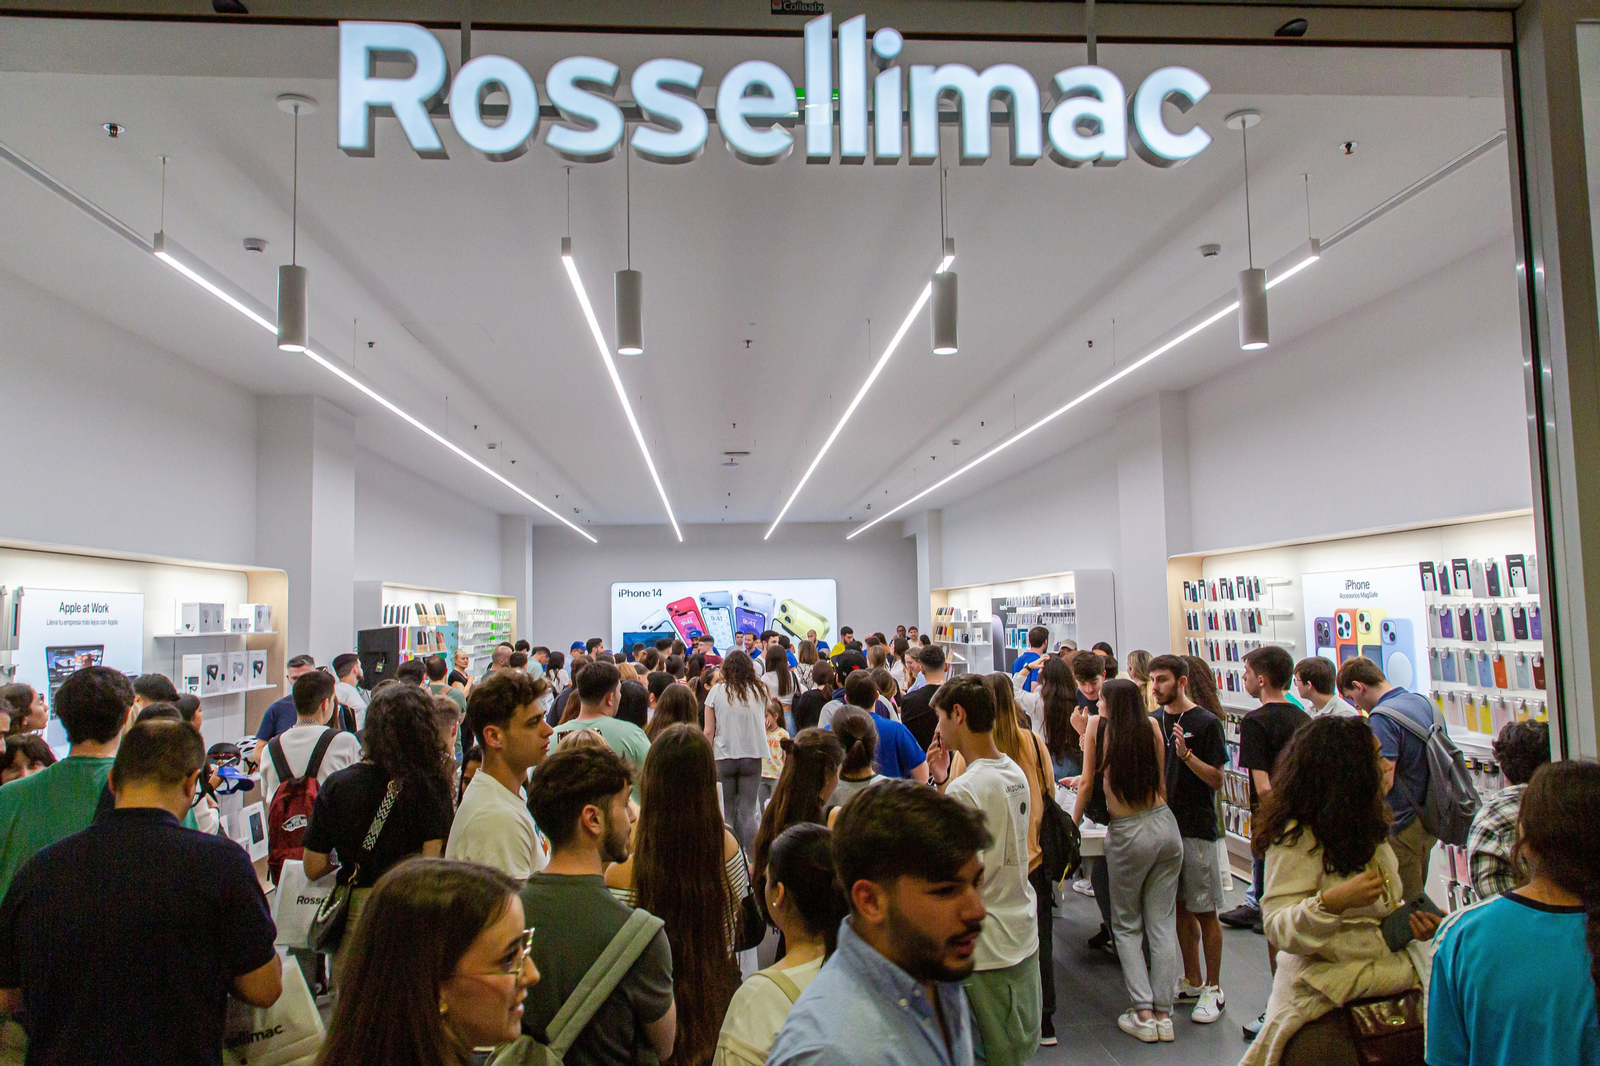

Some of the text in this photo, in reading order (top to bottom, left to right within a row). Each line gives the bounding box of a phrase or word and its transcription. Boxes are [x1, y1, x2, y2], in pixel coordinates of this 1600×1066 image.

[337, 12, 1212, 164] Rossellimac
[1345, 579, 1370, 590] iPhone
[618, 588, 662, 598] iPhone 14
[1360, 591, 1379, 599] MagSafe
[59, 602, 110, 615] Apple at Work
[63, 619, 81, 627] empresa
